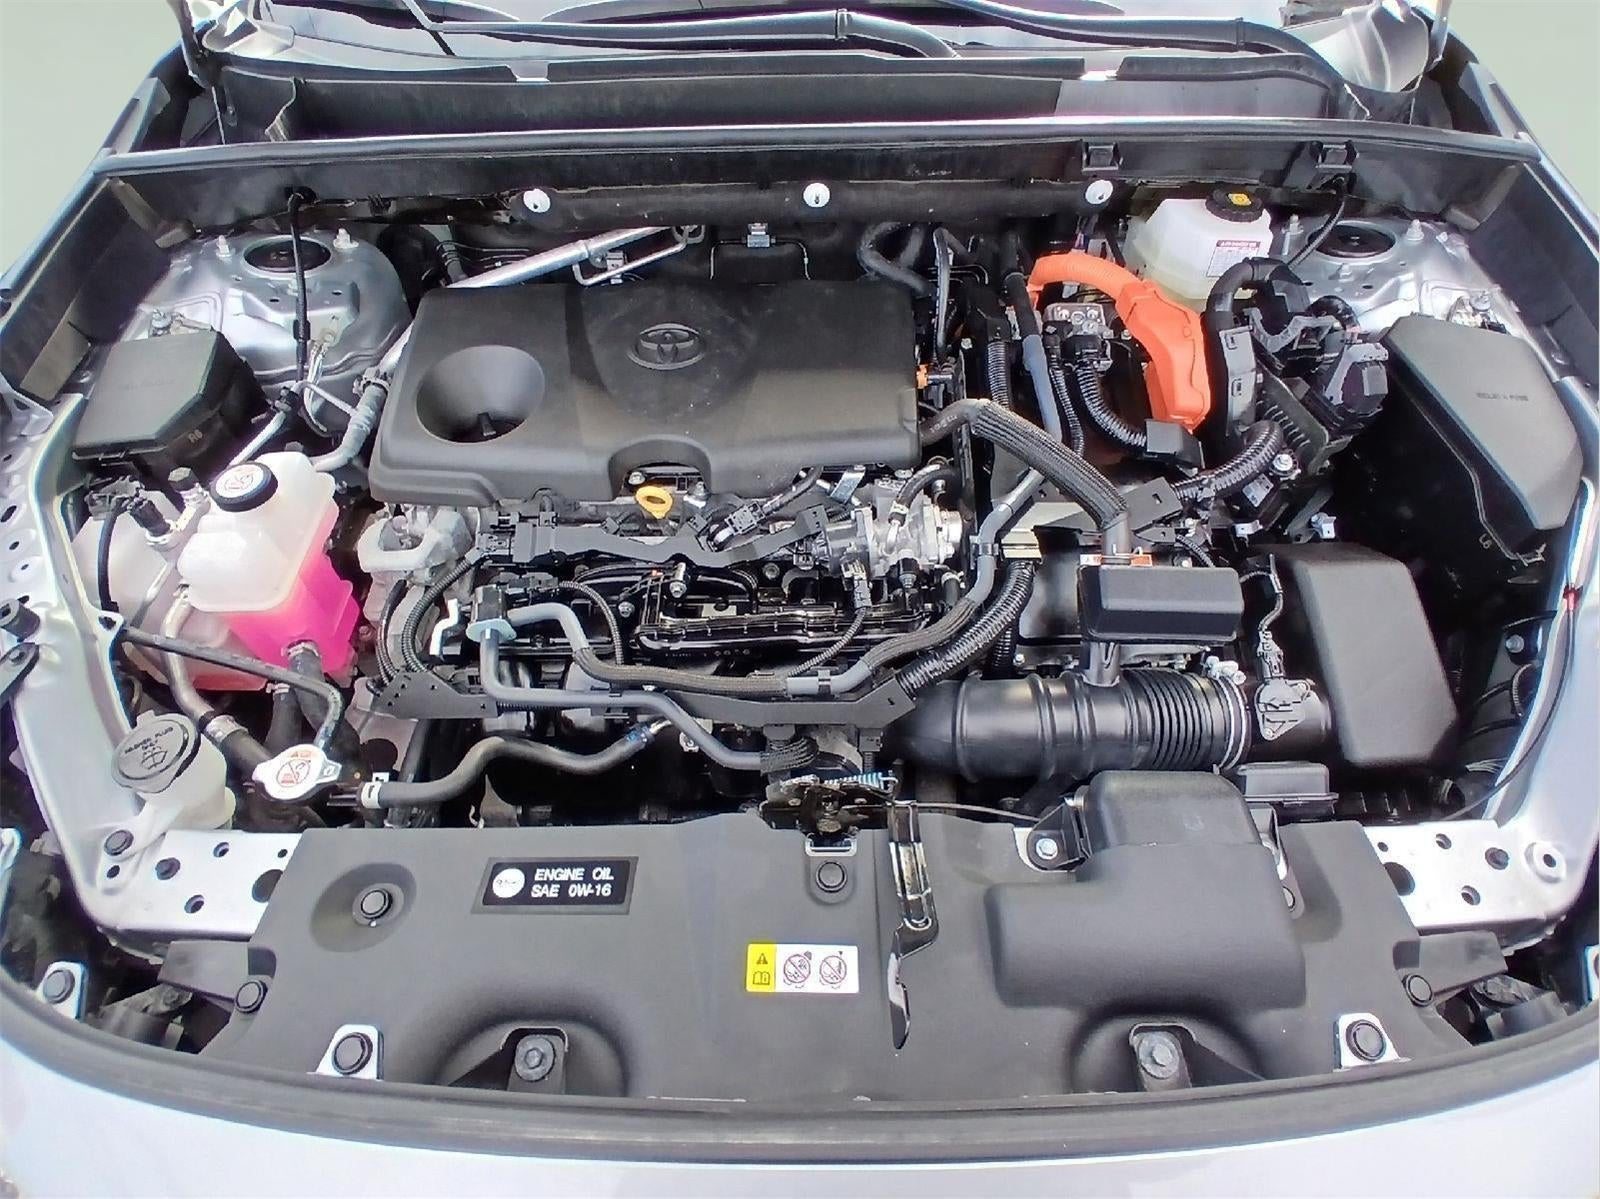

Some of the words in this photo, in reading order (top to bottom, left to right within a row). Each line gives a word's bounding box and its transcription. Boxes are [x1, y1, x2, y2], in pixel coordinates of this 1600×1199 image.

[534, 867, 585, 881] ENGINE
[592, 867, 614, 881] OIL
[531, 884, 560, 898] SAE
[568, 883, 612, 898] 0W-16
